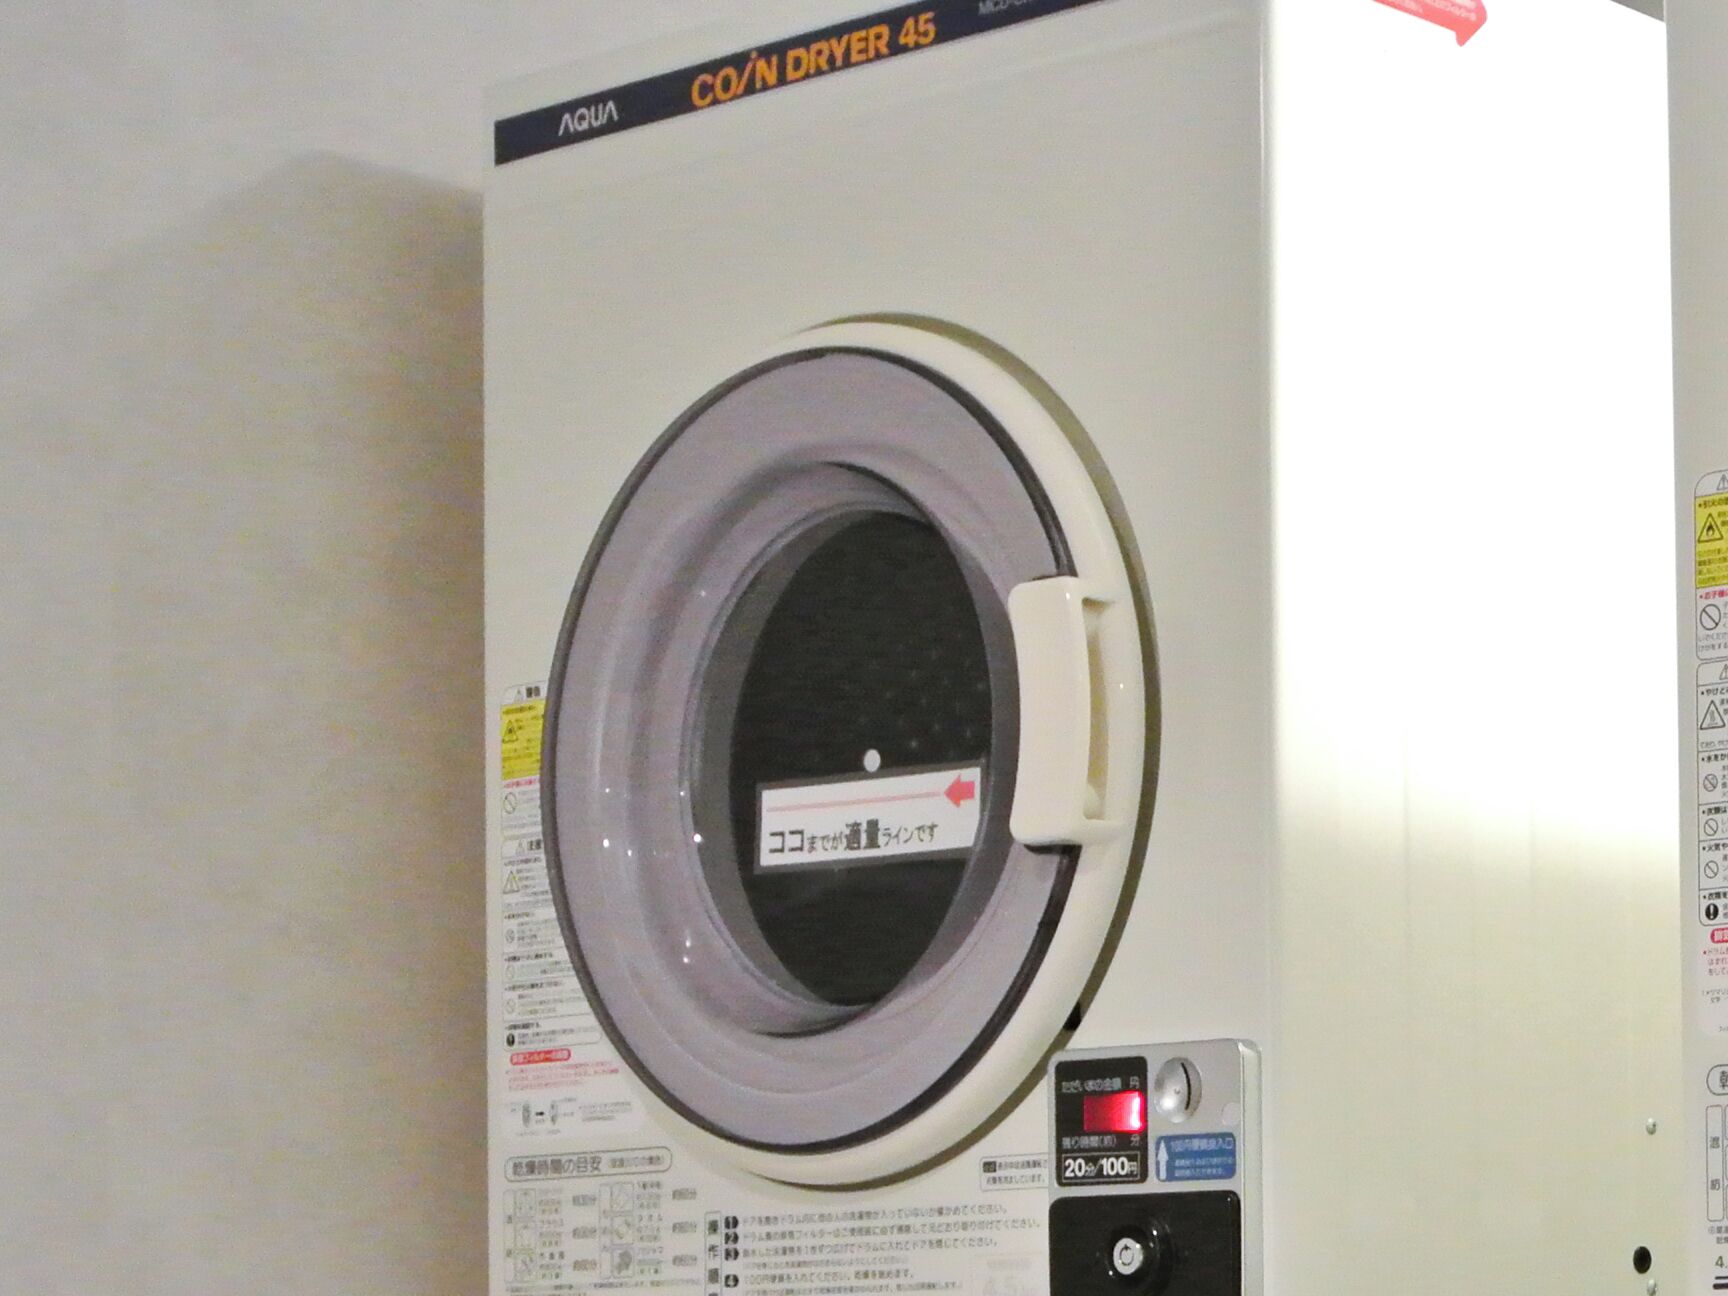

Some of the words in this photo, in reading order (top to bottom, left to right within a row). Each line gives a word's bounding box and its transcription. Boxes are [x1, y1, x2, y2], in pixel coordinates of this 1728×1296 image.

[786, 23, 890, 83] DRYER
[898, 11, 936, 47] 45
[558, 100, 618, 136] AQUA
[769, 818, 938, 854] ココまでが適量ラインです
